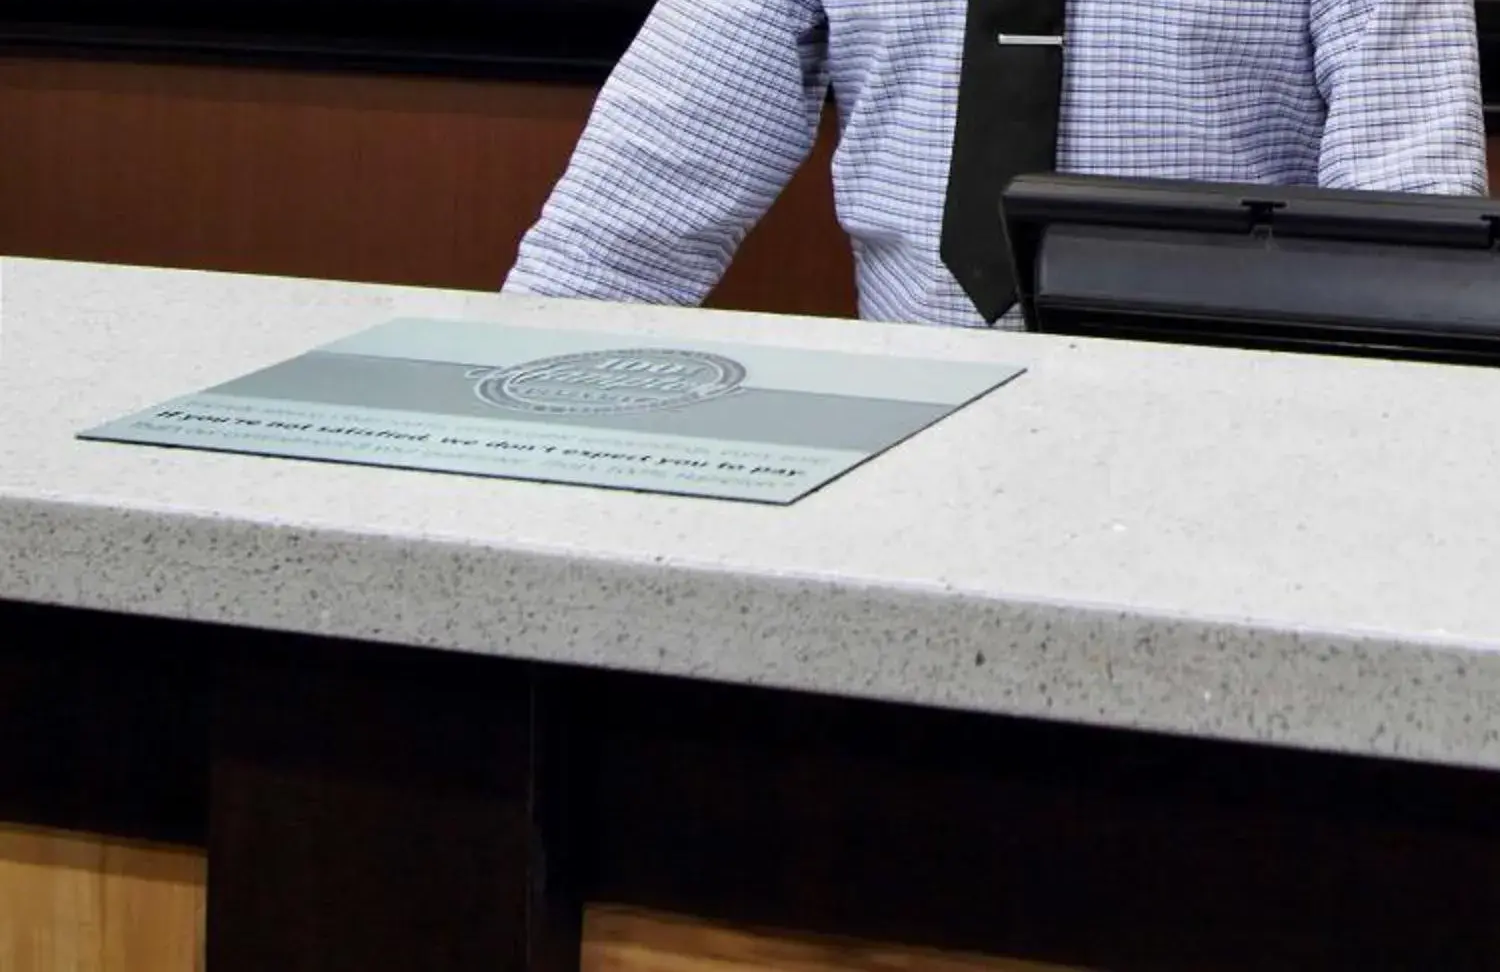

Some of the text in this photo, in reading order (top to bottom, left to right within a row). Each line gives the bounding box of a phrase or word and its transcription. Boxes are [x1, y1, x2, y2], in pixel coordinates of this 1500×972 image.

[180, 414, 262, 426] you're
[265, 421, 314, 431] not
[484, 440, 558, 453] don't
[561, 448, 652, 462] expect
[654, 456, 709, 468] you
[716, 461, 747, 470] to
